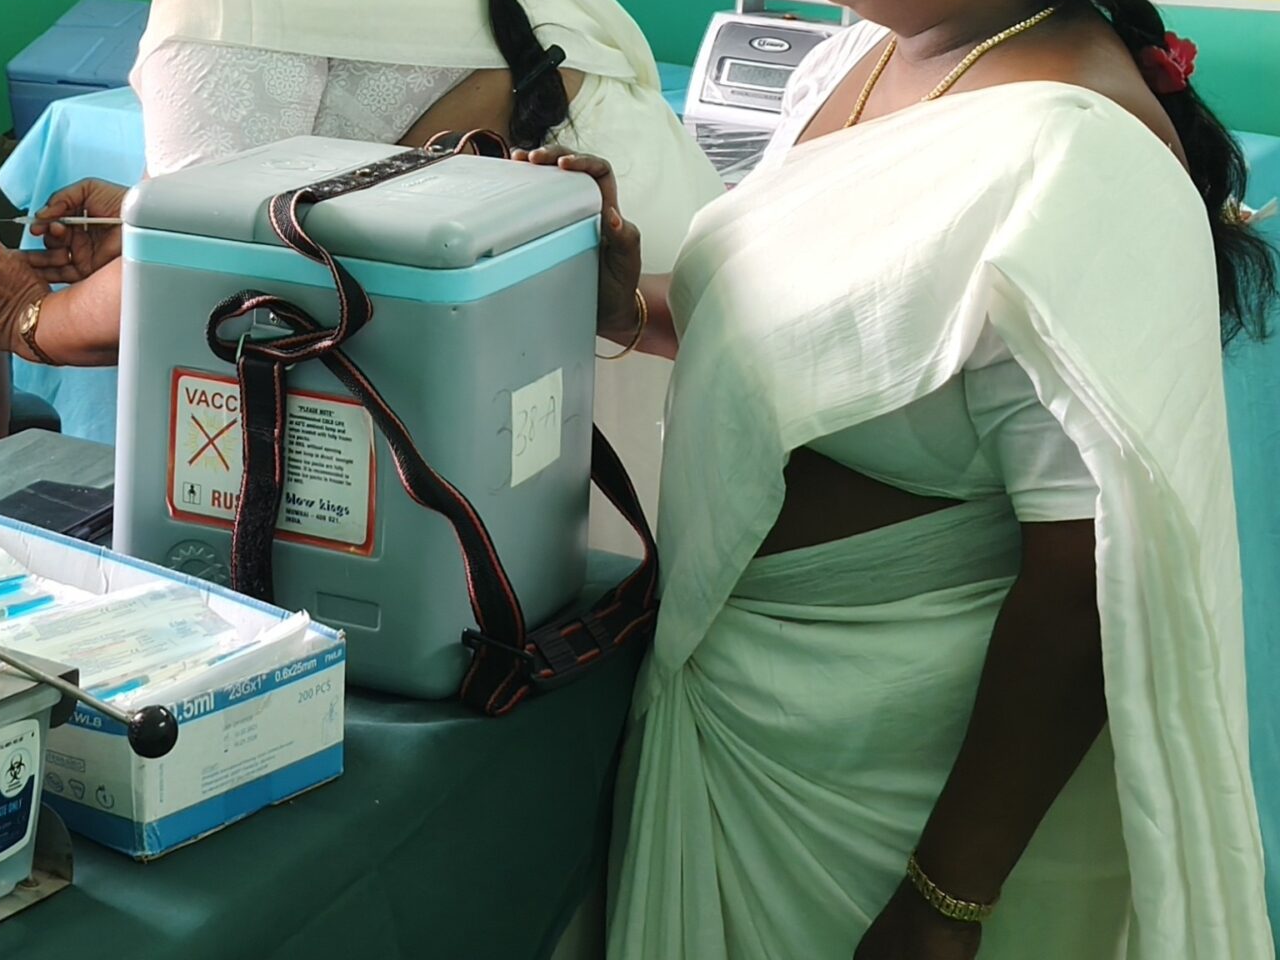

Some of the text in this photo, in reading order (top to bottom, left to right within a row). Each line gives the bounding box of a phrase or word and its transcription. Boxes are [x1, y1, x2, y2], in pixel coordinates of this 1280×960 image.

[185, 387, 240, 413] VACC
[211, 490, 241, 510] RUS
[297, 680, 333, 704] 200 PCS
